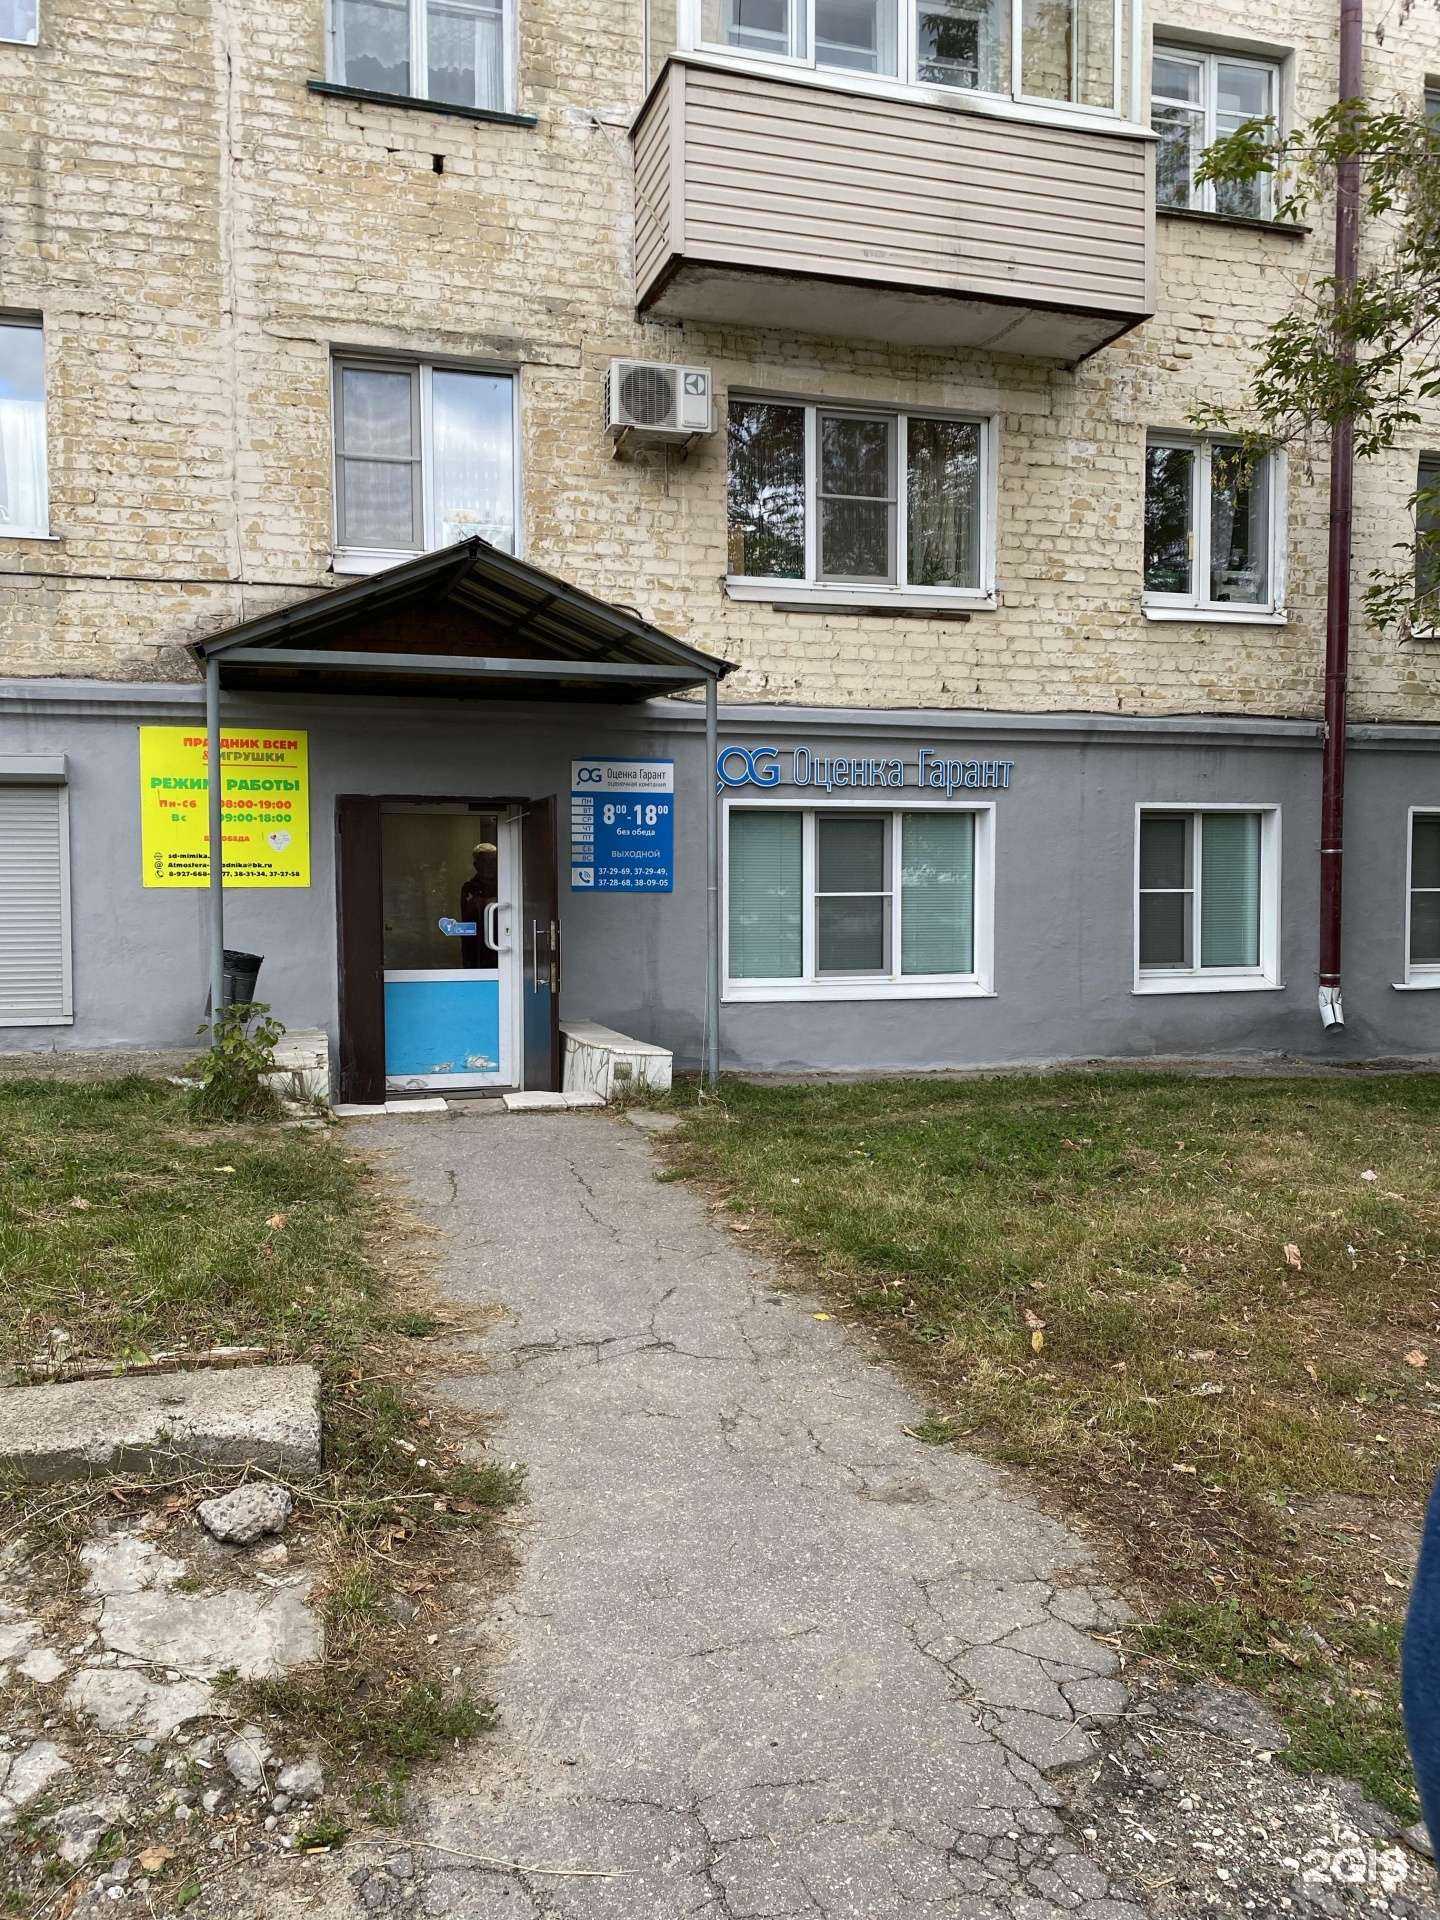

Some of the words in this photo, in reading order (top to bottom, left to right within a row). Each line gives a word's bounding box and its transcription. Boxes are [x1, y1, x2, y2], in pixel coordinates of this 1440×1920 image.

[183, 737, 259, 749] ПРАДНИК
[262, 739, 298, 750] ВСЕМ
[607, 767, 637, 779] Оценка
[639, 768, 666, 780] Гарант
[793, 746, 905, 793] Оценка
[918, 748, 1015, 797] Гарант
[226, 778, 300, 791] РАБОТЫ
[616, 827, 630, 835] без
[632, 828, 656, 836] обеда
[611, 848, 660, 858] ВЫХОДНОЙ
